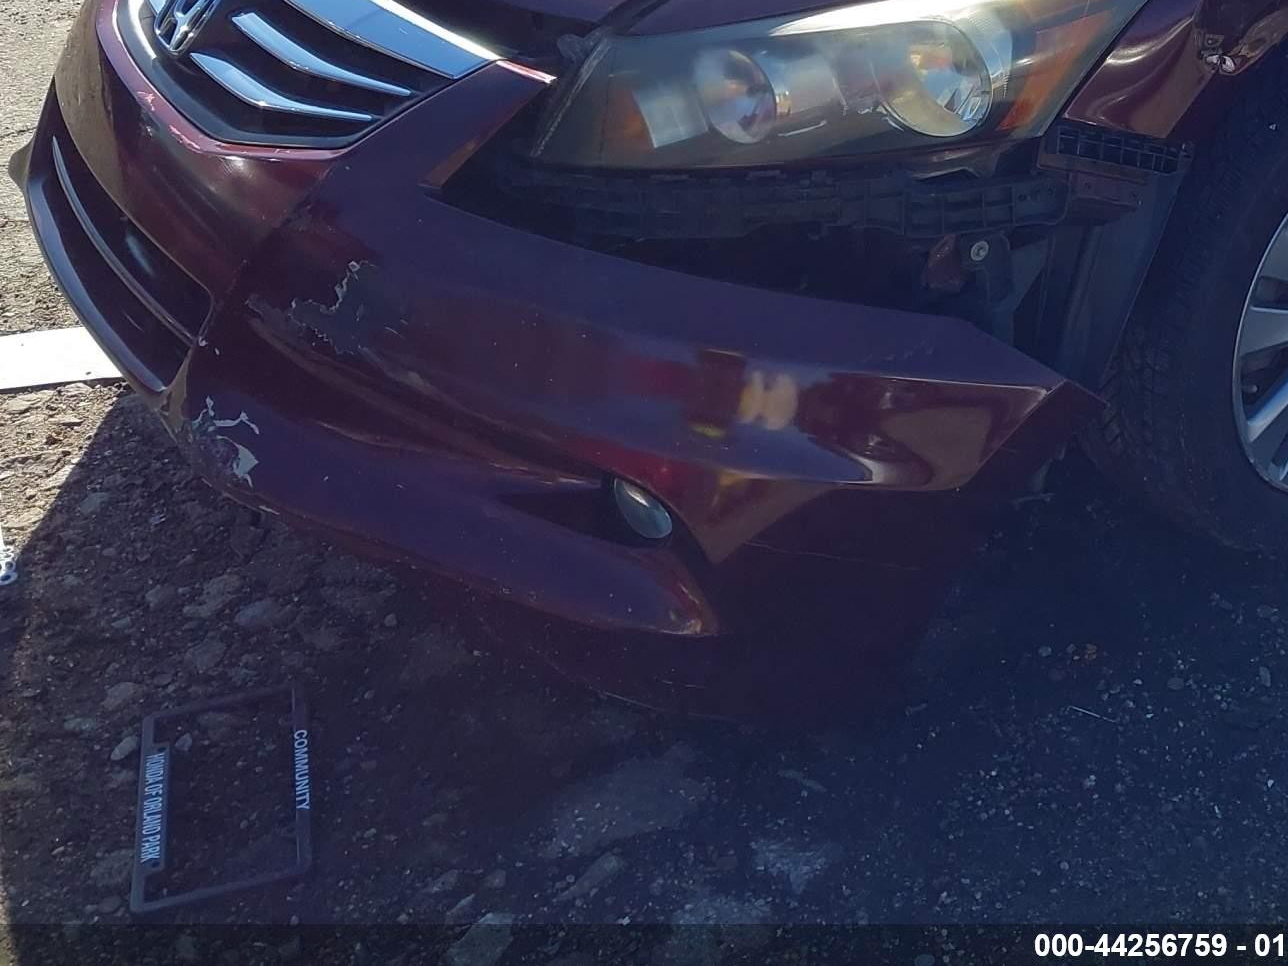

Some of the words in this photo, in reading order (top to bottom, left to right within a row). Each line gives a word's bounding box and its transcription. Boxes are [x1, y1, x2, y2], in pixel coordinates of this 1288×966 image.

[145, 752, 166, 785] HONDA
[293, 729, 311, 810] COMMUNITY
[144, 784, 163, 796] OF
[142, 797, 163, 835] ORLAND
[140, 834, 160, 864] PARK
